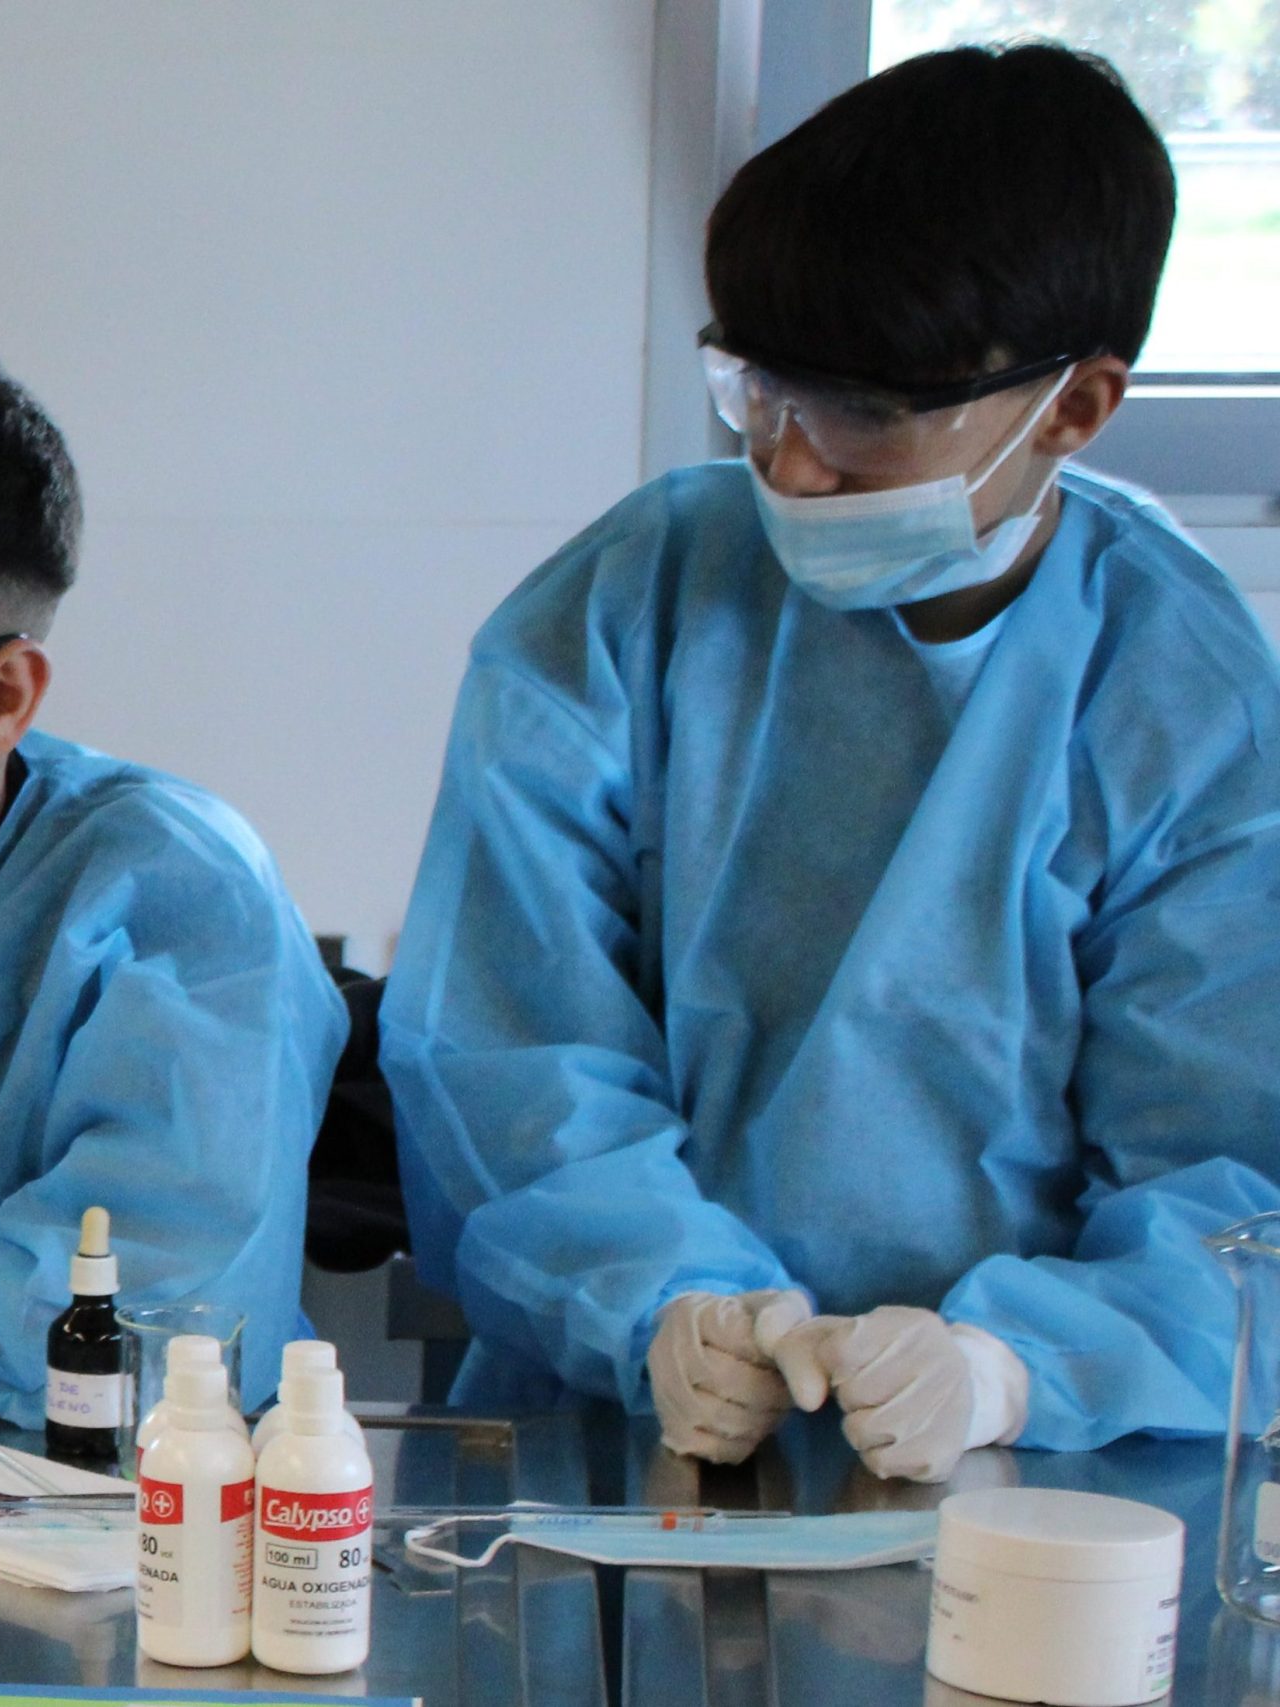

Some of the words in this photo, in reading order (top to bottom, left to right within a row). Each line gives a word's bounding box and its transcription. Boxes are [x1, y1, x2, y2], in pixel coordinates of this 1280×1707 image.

[266, 1499, 352, 1532] Calypso
[268, 1550, 289, 1564] 100
[293, 1555, 310, 1566] ml
[339, 1547, 361, 1569] 80
[262, 1576, 297, 1592] AGUA
